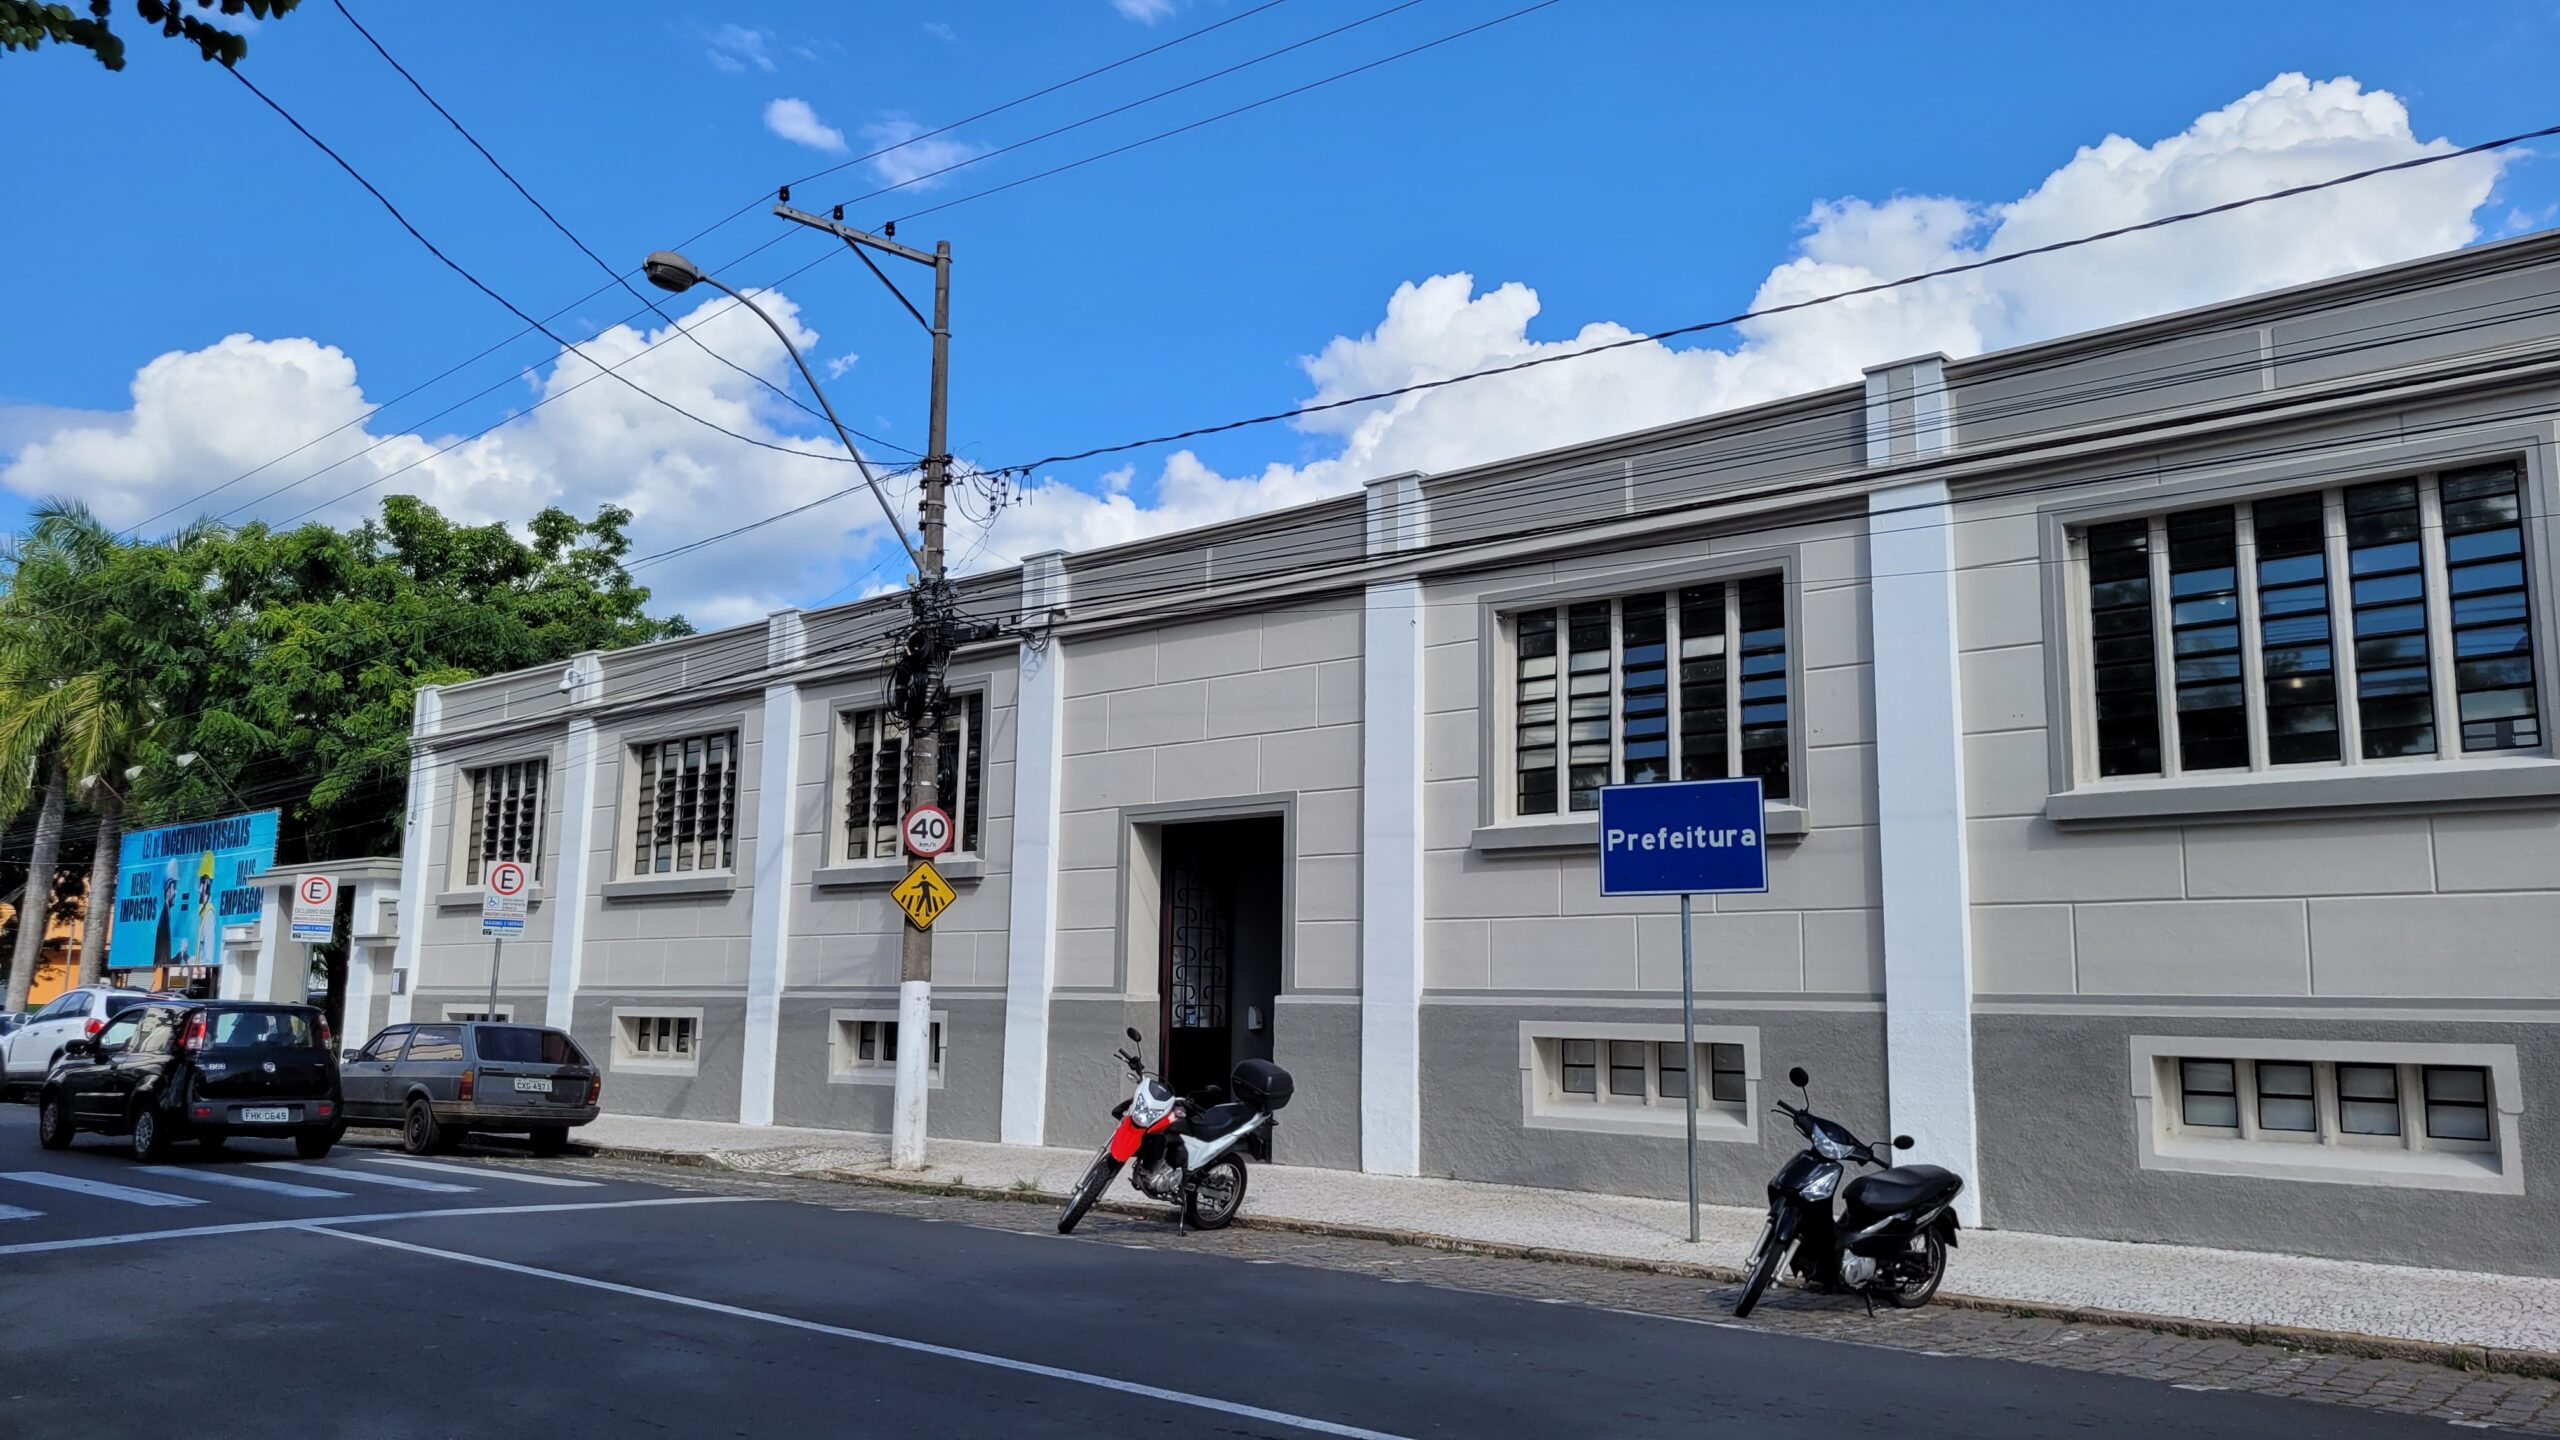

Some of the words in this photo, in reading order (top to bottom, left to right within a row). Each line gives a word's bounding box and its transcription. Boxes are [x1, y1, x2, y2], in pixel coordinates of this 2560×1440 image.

[143, 833, 152, 859] LEI
[162, 825, 212, 857] INCENTIVOS
[212, 818, 251, 850] FISCAIS
[910, 818, 945, 839] 40
[1607, 826, 1756, 852] Prefeitura
[131, 872, 151, 896] MENOS
[236, 858, 256, 887] MAIS
[501, 869, 515, 889] E
[309, 881, 323, 899] E
[120, 897, 157, 922] IMPOSTOS
